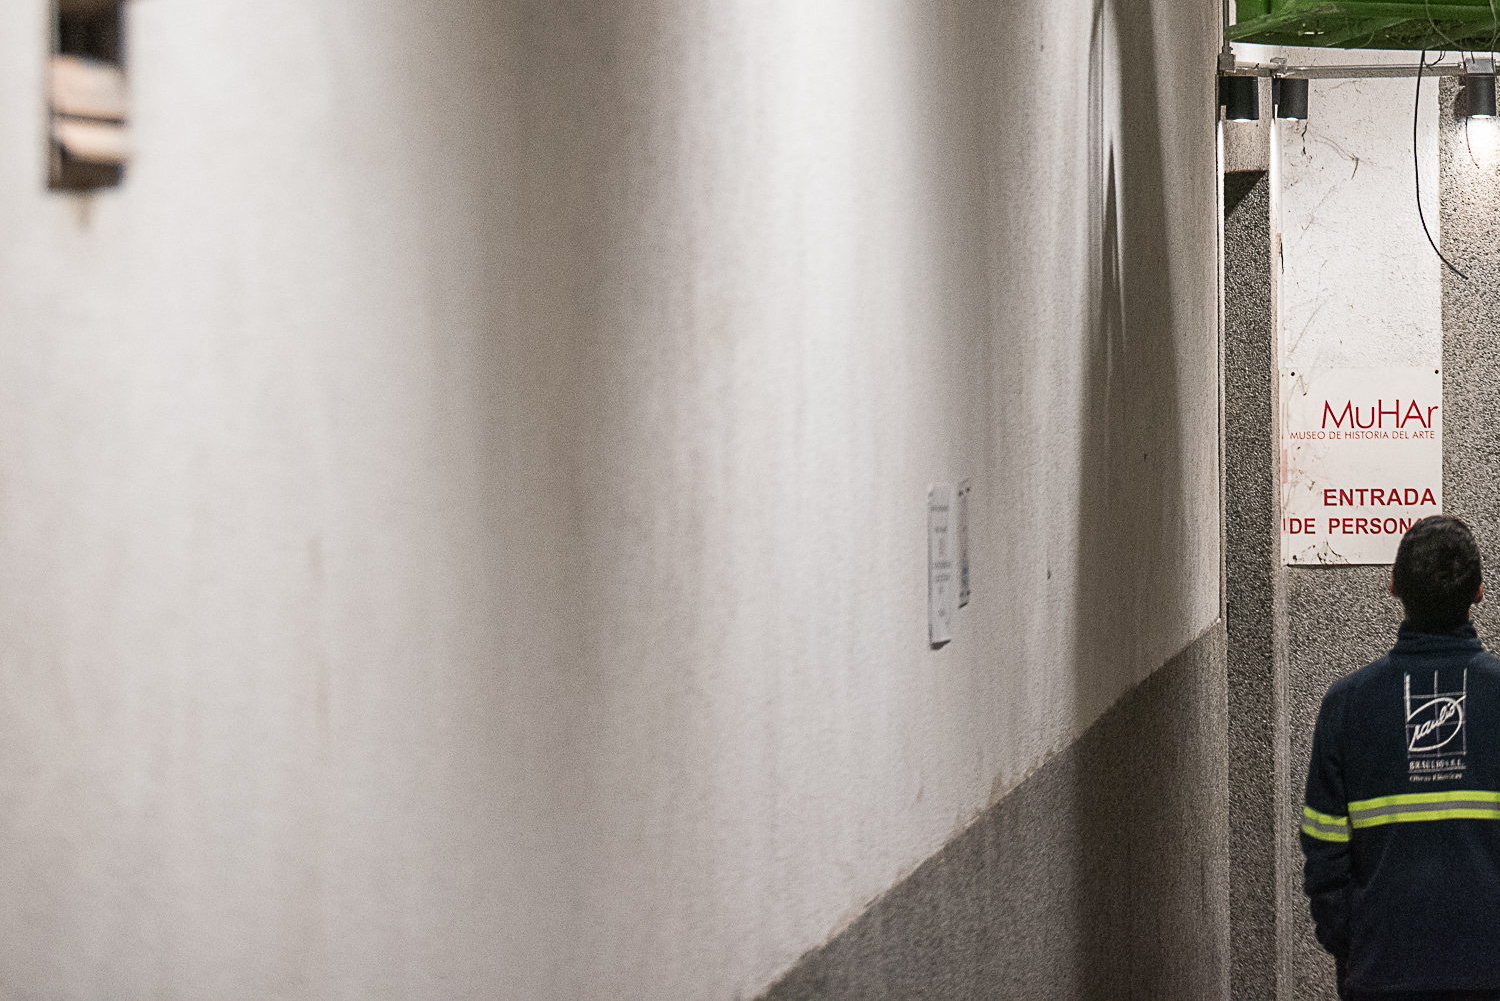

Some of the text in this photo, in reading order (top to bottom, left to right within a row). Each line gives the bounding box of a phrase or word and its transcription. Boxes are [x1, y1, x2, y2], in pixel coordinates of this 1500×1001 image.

[1321, 399, 1439, 429] MuHAr
[1289, 430, 1435, 440] MUSEO DE HISTORIA DEL ARTE
[1323, 488, 1437, 507] ENTRADA
[1289, 517, 1422, 535] DE PERSON
